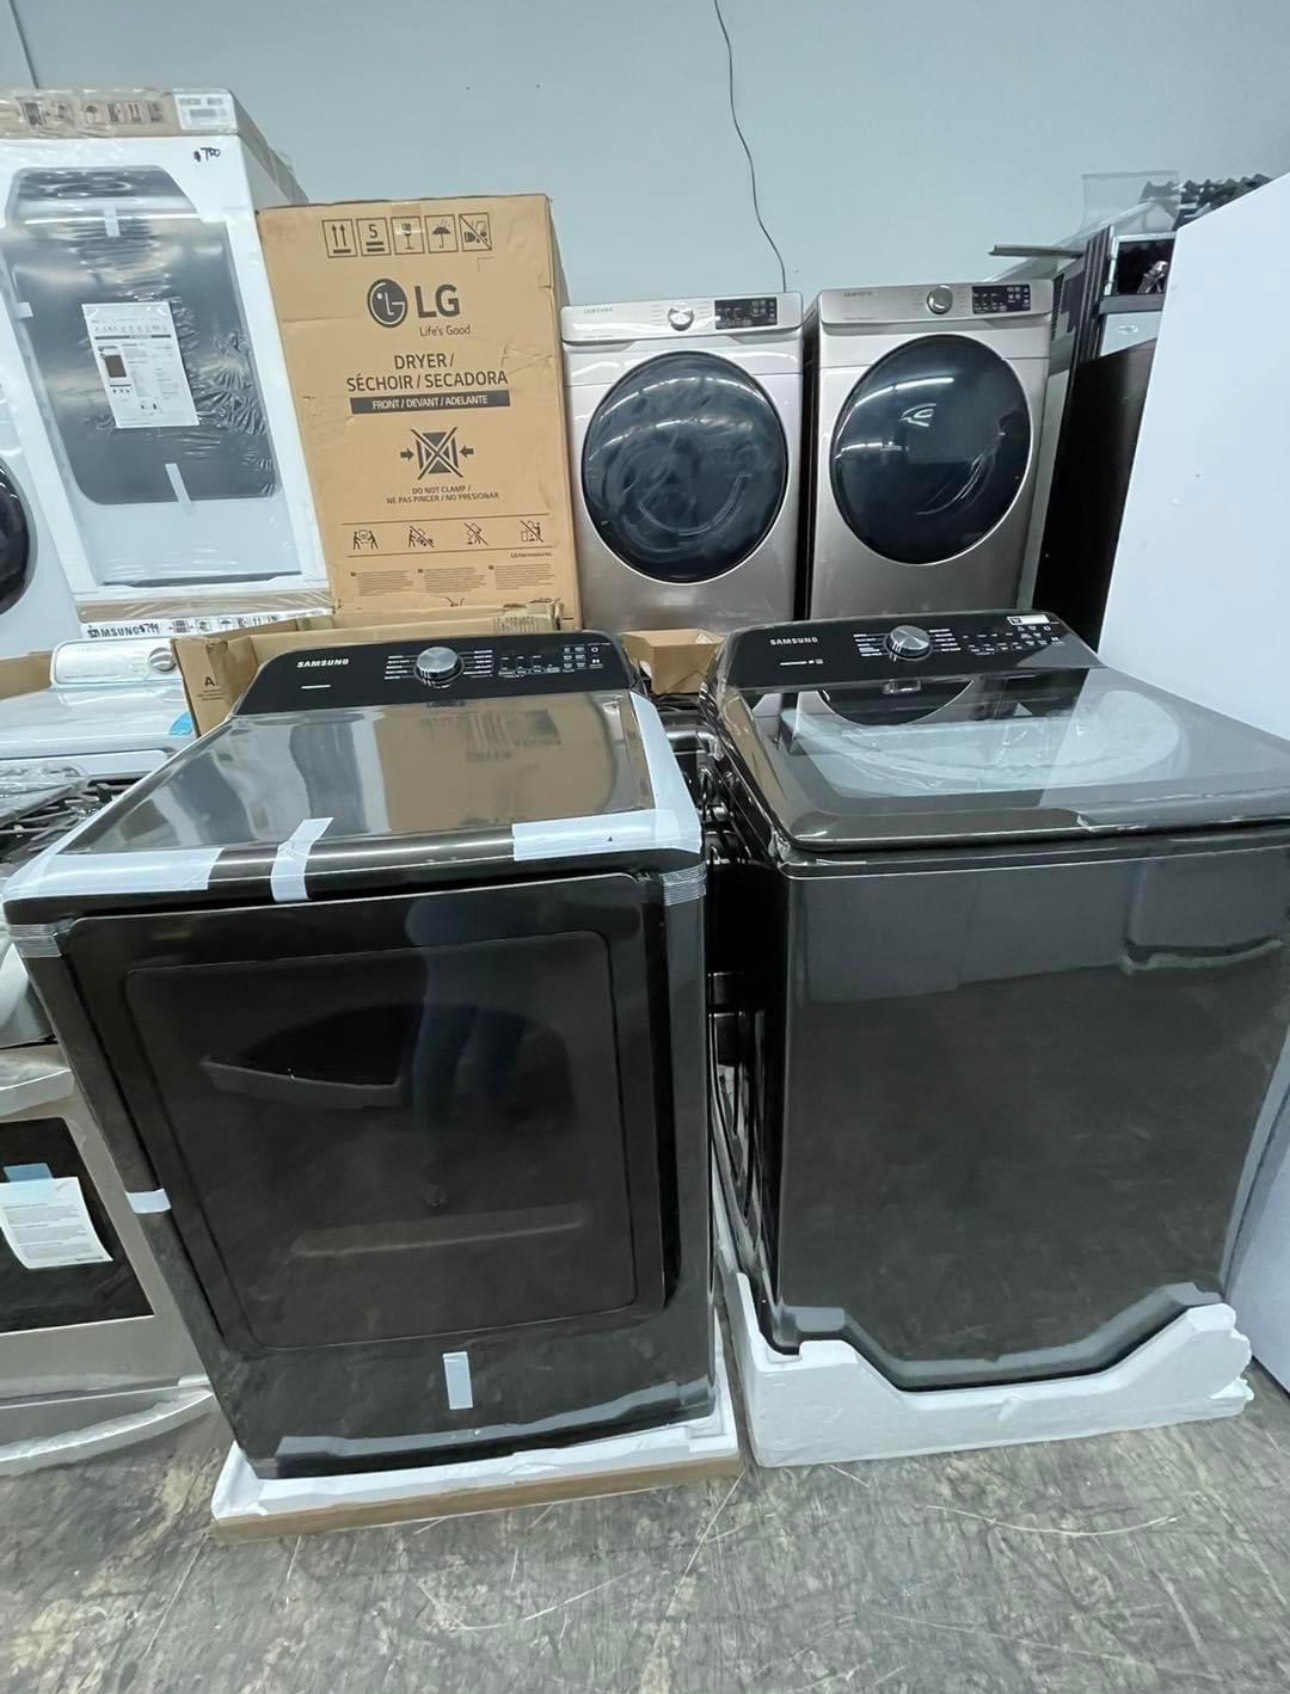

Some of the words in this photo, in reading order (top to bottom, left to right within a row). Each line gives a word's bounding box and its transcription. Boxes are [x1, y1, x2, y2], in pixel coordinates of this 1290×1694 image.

[414, 284, 460, 319] LG
[420, 325, 443, 337] Life's
[446, 324, 471, 336] Good
[394, 353, 447, 370] DRYER
[346, 373, 413, 392] SÉCHOIR
[416, 374, 421, 389] /
[424, 370, 508, 388] SECADORA
[372, 399, 400, 411] FRONT
[406, 396, 440, 409] DEVANT
[445, 394, 488, 406] ADELANTE
[411, 487, 423, 495] DO
[424, 486, 440, 494] NOT
[441, 485, 466, 493] CLAMP
[770, 636, 818, 645] SAMSUNG
[297, 658, 350, 668] SAMSUNG
[204, 676, 215, 686] A
